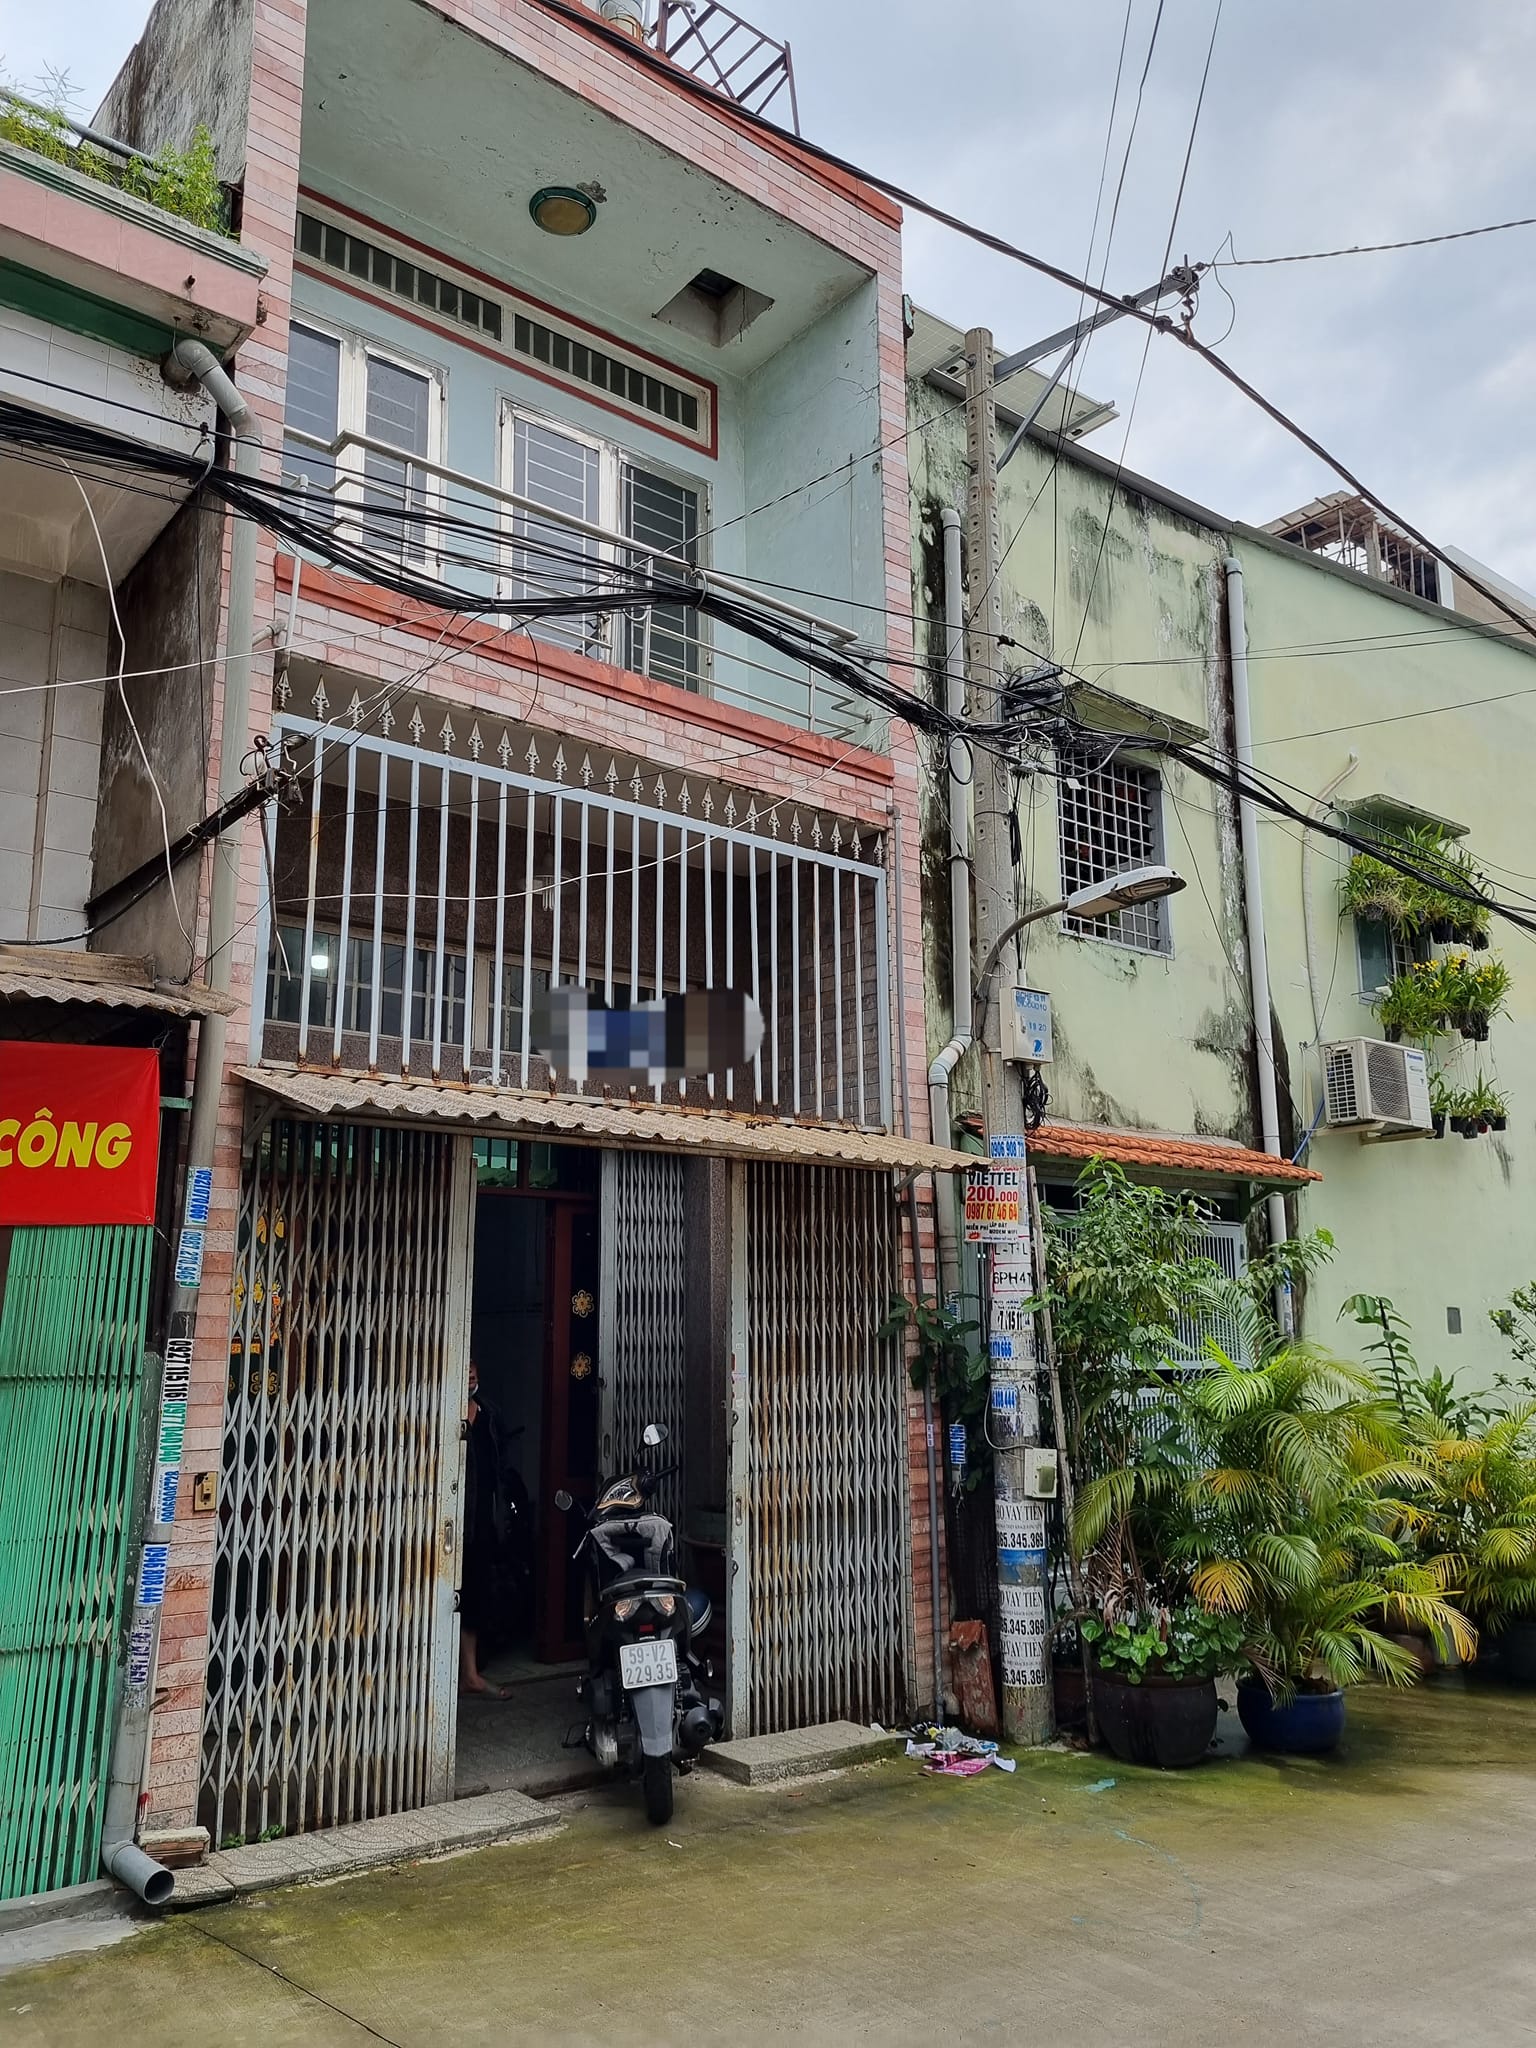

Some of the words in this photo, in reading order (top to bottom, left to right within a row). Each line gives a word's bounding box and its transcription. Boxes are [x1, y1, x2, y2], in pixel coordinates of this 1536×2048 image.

[0, 1107, 132, 1169] CÔNG
[968, 1171, 1018, 1186] VIETTEL
[966, 1186, 1018, 1202] 200.000
[966, 1203, 985, 1220] 0987
[986, 1203, 996, 1220] 67
[997, 1203, 1007, 1220] 46
[1008, 1203, 1018, 1220] 64
[626, 1662, 674, 1685] 229.35
